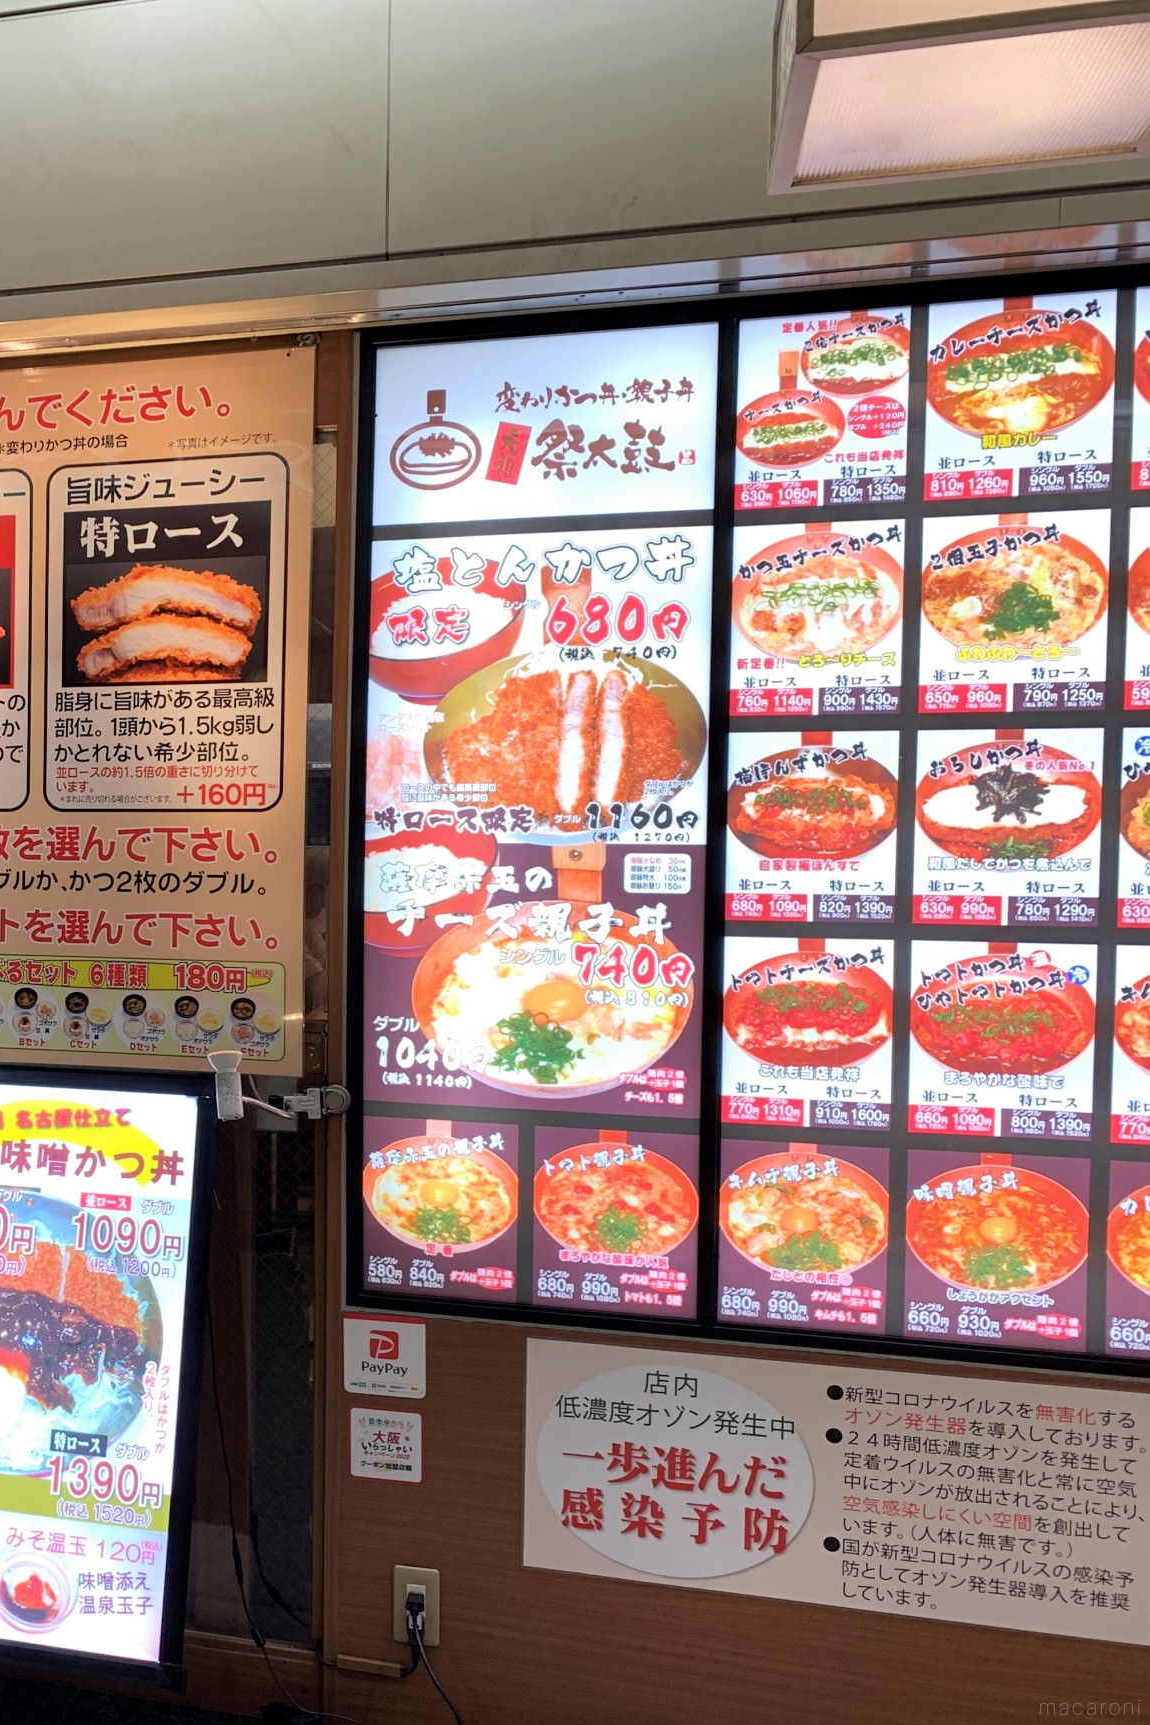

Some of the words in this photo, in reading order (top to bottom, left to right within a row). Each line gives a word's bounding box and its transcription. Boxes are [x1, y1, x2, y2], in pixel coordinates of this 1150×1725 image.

[929, 298, 1102, 363] カレーチーズかつ丼
[744, 391, 824, 422] チーズかつ丼
[531, 418, 675, 481] 祭太鼓
[824, 449, 905, 464] これも当店発祥
[981, 432, 1058, 450] 和風カレー
[66, 469, 265, 506] 旨味ジューシー
[80, 513, 244, 558] 特ロース
[930, 523, 1061, 571] 2個玉子かつ丼
[393, 535, 695, 593] 塩とんかつ丼
[738, 524, 902, 581] かつ玉チーズかつ丼
[386, 605, 472, 645] 限定
[545, 593, 691, 646] 680円
[737, 658, 785, 671] 新定番!!
[55, 688, 275, 712] 脂身に旨味がある最高級
[54, 741, 249, 763] かとれない希少部位。
[929, 739, 1044, 779] おろしかつ丼
[56, 781, 95, 793] います。
[374, 806, 534, 833] 特ロース限定
[585, 803, 699, 830] 1160円
[387, 899, 673, 944] チーズ親子丼
[89, 962, 149, 989] 6種類
[174, 962, 247, 993] 180円
[572, 943, 696, 988] 740円
[730, 946, 885, 992] トマトチーズかつ丼
[920, 953, 1025, 989] トマトかつ丼
[1069, 967, 1088, 984] 冷
[916, 970, 1066, 1010] ひやトマトかつ丼
[19, 1038, 45, 1047] Bセット
[70, 1040, 97, 1049] Cセット
[130, 1042, 157, 1052] Dセット
[182, 1045, 209, 1055] Eセット
[758, 1065, 861, 1083] これも当店発祥
[15, 1108, 131, 1130] 名古屋仕立て
[542, 1144, 647, 1177] トマト親子丼
[728, 1158, 839, 1190] キムチ親子丼
[84, 1194, 128, 1209] 並ロース
[141, 1200, 175, 1215] ダブル
[73, 1214, 182, 1259] 1090円
[368, 1264, 403, 1279] 580円
[409, 1267, 445, 1283] 840円
[538, 1277, 575, 1292] 680円
[581, 1280, 619, 1297] 990円
[908, 1311, 949, 1326] 660円
[958, 1315, 1000, 1330] 930円
[362, 1361, 408, 1377] PayPay
[643, 1370, 698, 1398] 店内
[555, 1394, 795, 1440] 低濃度オゾン発生中
[845, 1386, 1135, 1429] 新型コロナウイルスを無害化する
[54, 1432, 101, 1453] 特ロース
[116, 1444, 149, 1460] ダブル
[372, 1431, 401, 1444] 大阪
[845, 1408, 1147, 1454] オゾン発生器を導入しております。
[362, 1442, 412, 1452] いらっしゃい
[49, 1456, 162, 1508] 1390円
[562, 1441, 787, 1500] 一歩進んだ
[844, 1452, 1137, 1498] 定着ウイルスの無害化と常に空気
[843, 1474, 1145, 1522] 中にオゾンが放出されることにより、
[94, 1503, 152, 1527] 1520円)
[561, 1487, 790, 1554] 感染予防
[842, 1496, 1131, 1542] 空気感染しにくい空間を創出して
[6, 1527, 87, 1557] みそ温玉
[97, 1540, 155, 1565] 120円
[842, 1539, 1135, 1587] 国が新型コロナウイルスの感染予
[78, 1573, 151, 1591] 味噌添え
[841, 1560, 1131, 1611] 防としてオゾン発生器導入を推奨
[842, 1582, 937, 1610] しています。
[78, 1596, 154, 1616] 温泉玉子
